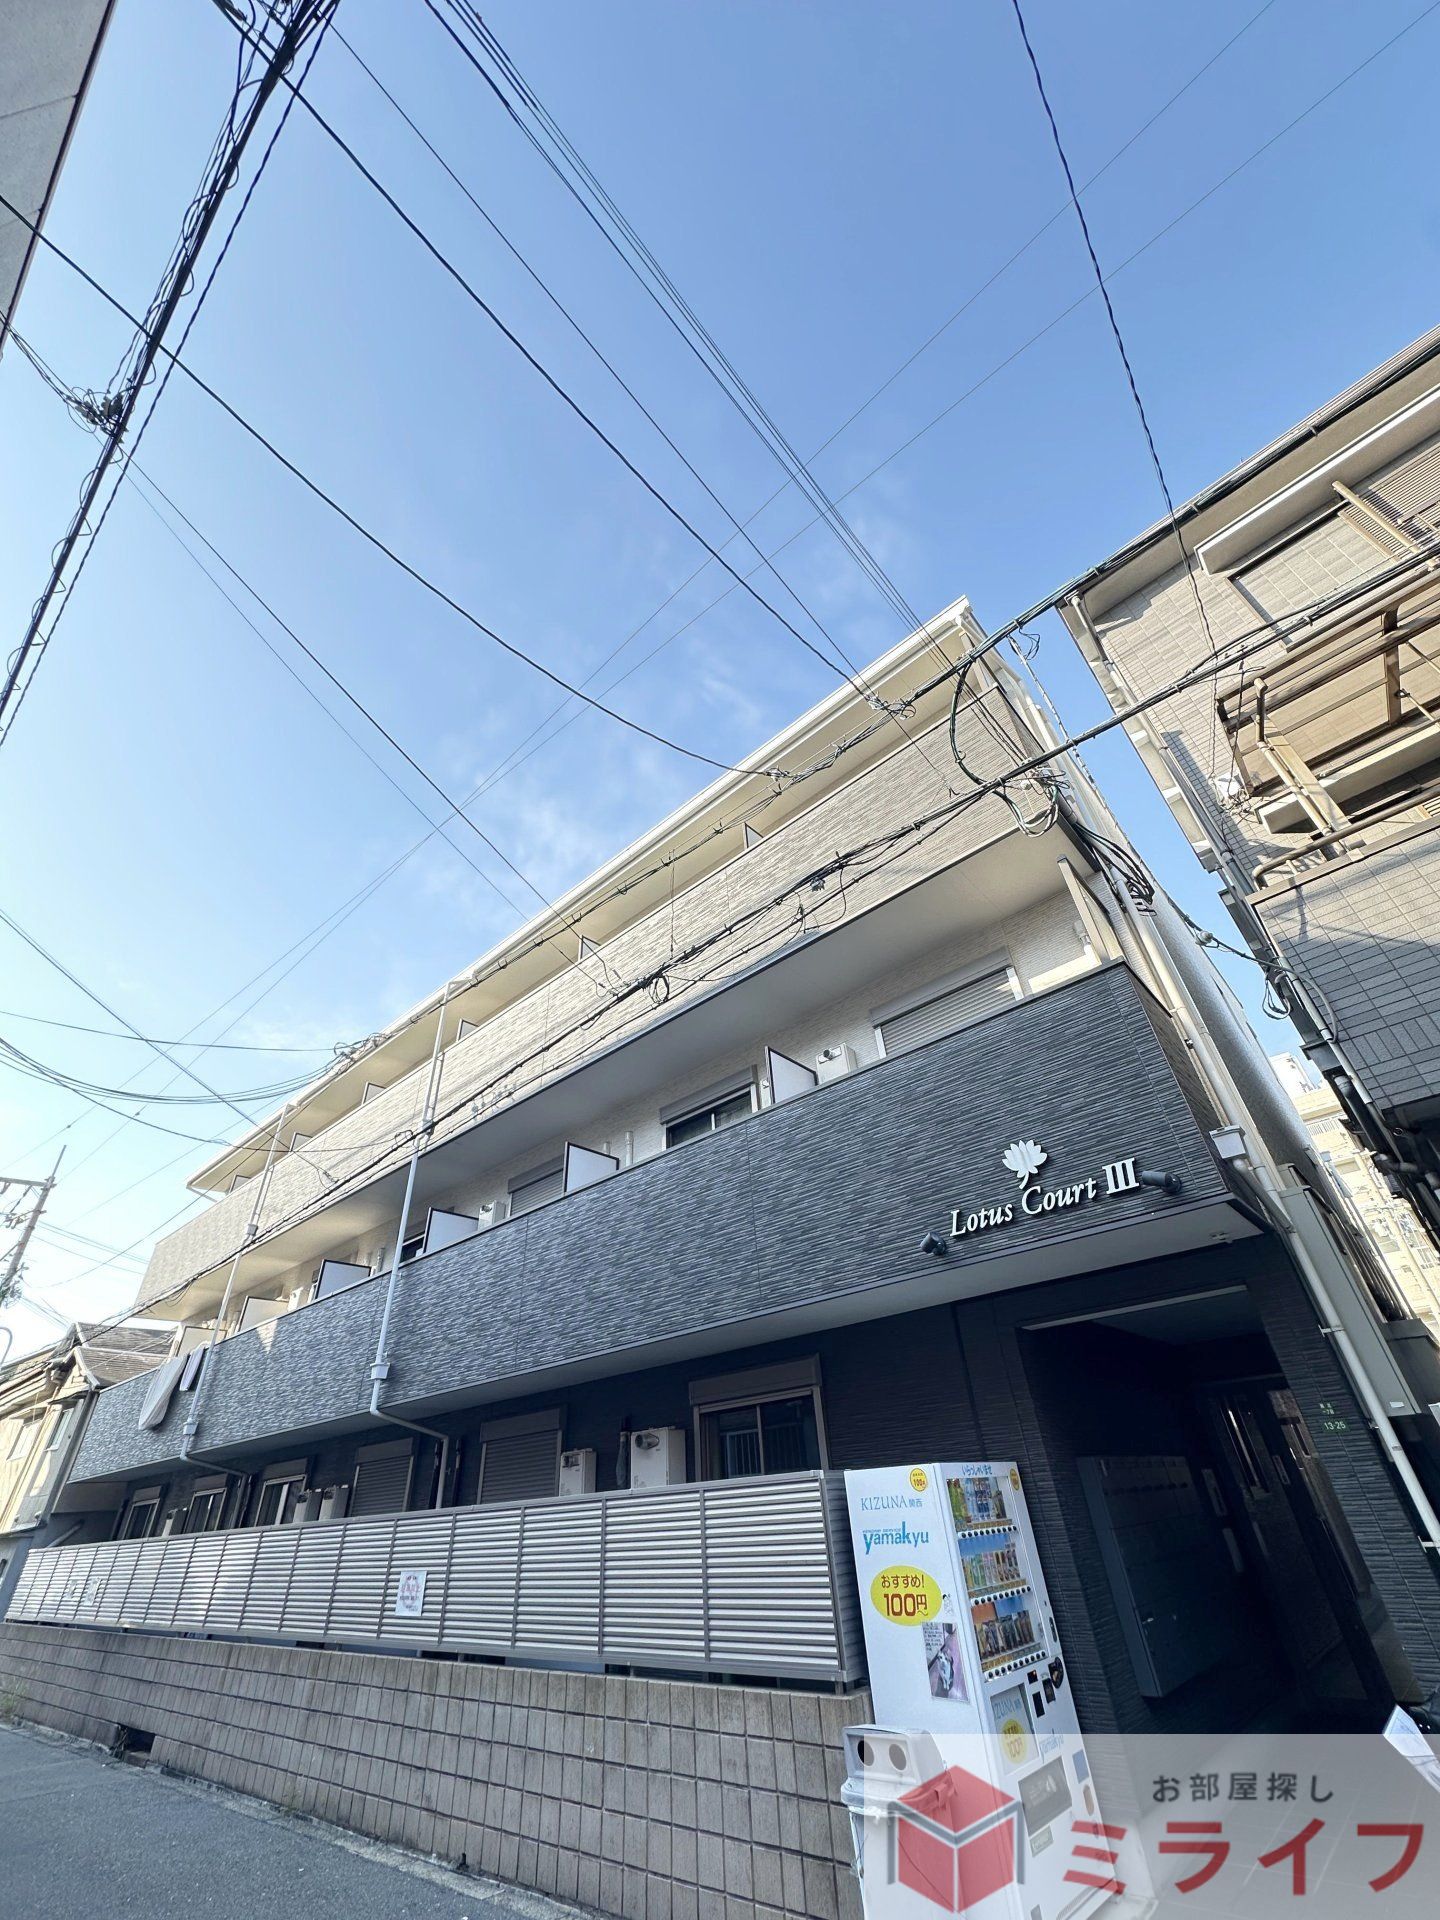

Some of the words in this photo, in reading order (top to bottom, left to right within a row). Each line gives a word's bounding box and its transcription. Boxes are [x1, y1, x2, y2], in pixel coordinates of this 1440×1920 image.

[950, 1203, 1013, 1237] Lotus
[1021, 1178, 1097, 1215] Court
[863, 1521, 930, 1555] yamakyu
[881, 1574, 925, 1588] おすすめ!
